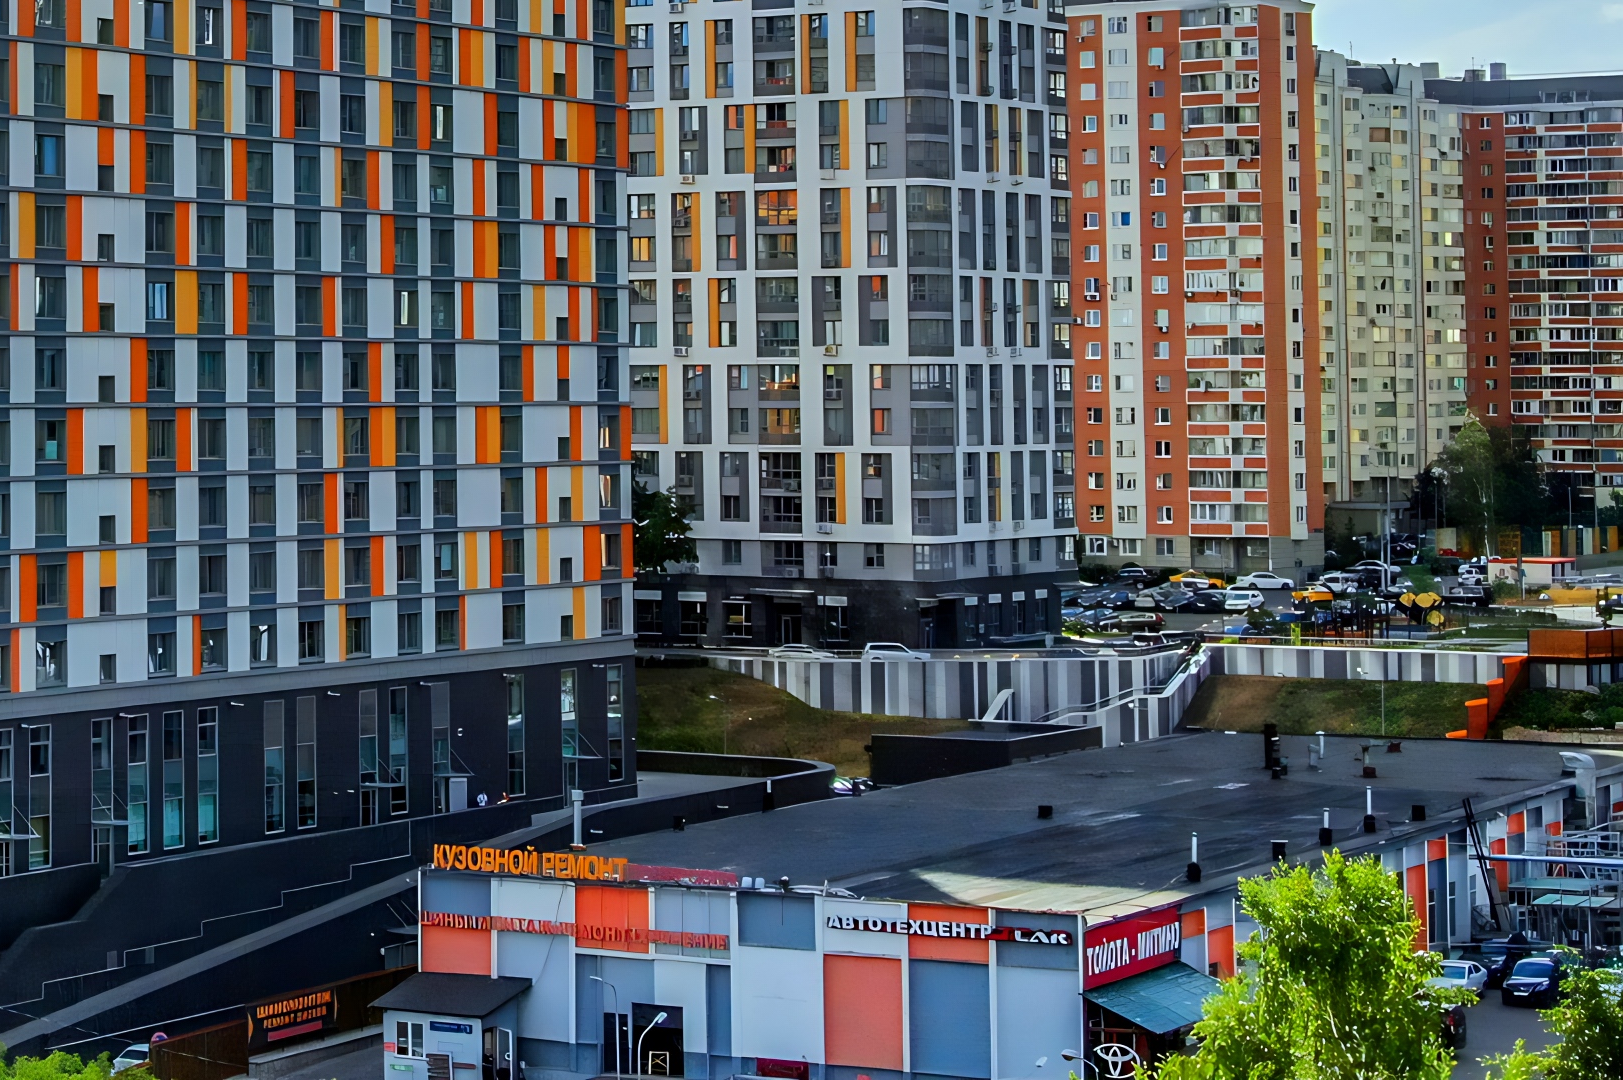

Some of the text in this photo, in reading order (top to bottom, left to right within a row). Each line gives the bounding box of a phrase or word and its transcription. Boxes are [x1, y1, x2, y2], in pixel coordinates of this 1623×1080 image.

[433, 843, 628, 882] КУЗОВНОЙ РЕМОНТ
[827, 914, 992, 939] АВТОТЕХЦЕНТР
